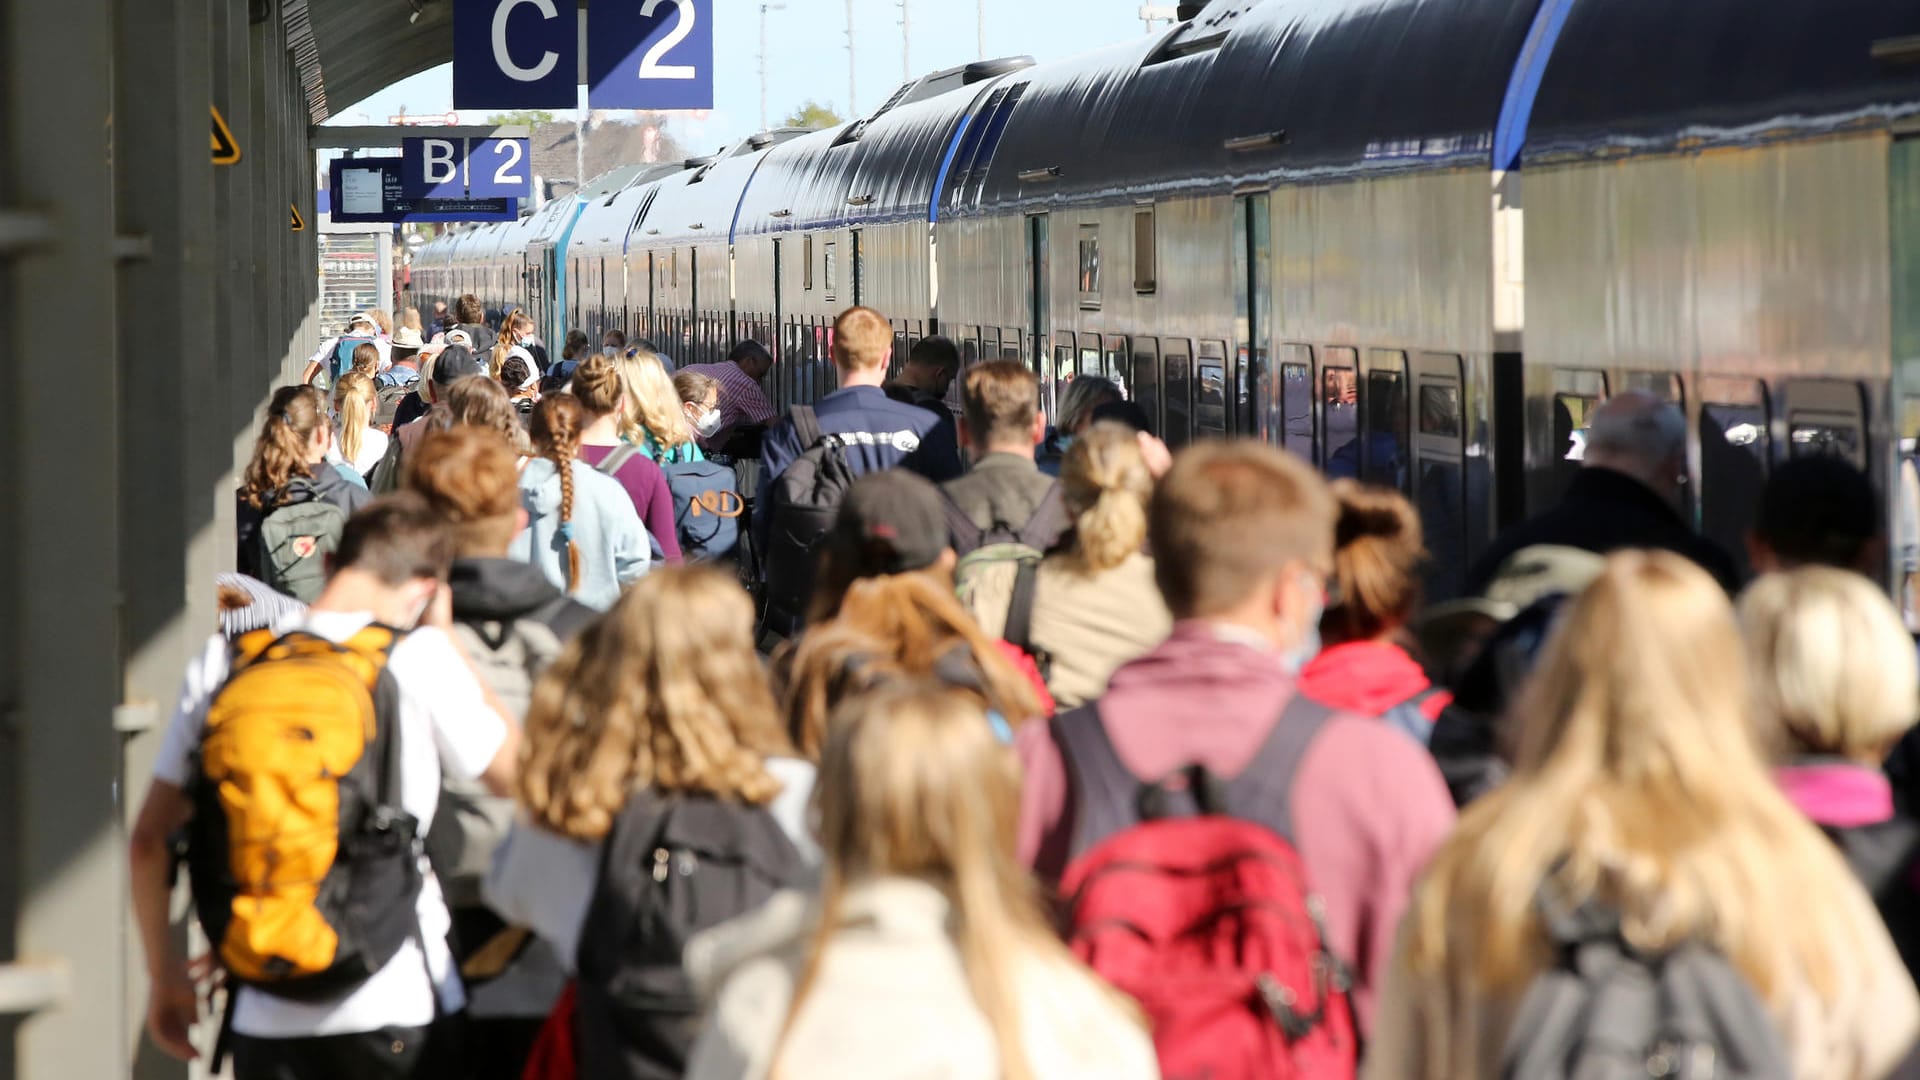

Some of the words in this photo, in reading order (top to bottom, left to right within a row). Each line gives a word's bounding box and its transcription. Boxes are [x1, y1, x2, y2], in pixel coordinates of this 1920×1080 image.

[491, 0, 559, 82] C
[638, 0, 696, 80] 2
[423, 139, 457, 185] B
[493, 139, 523, 184] 2
